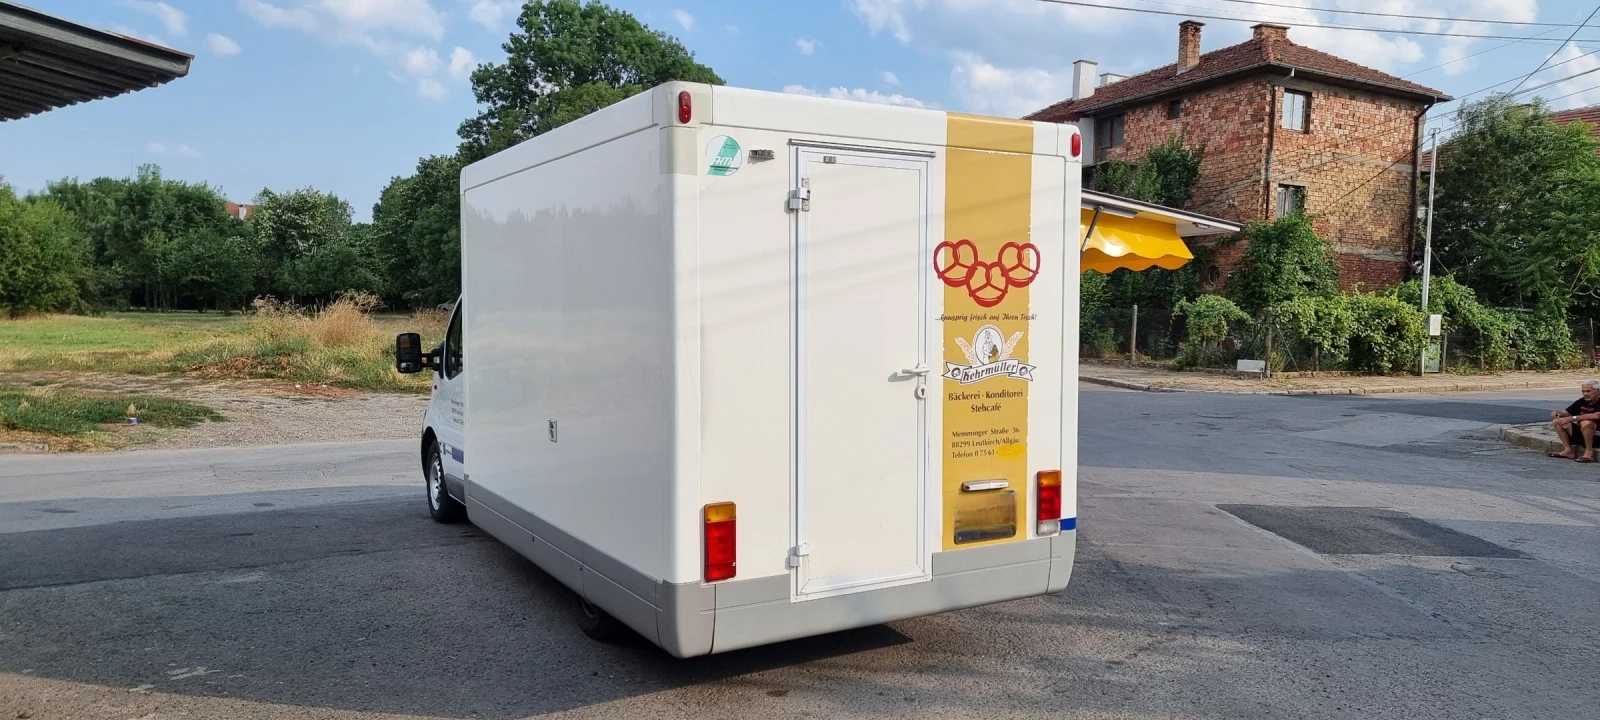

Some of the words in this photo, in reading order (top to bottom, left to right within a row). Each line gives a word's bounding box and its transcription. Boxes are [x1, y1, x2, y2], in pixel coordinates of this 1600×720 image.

[969, 313, 987, 322] frisch
[988, 313, 1000, 322] auf
[1001, 312, 1019, 321] Ihren
[962, 360, 1017, 382] Kehrmüller
[948, 391, 981, 402] Bäckerei
[985, 388, 1024, 400] Konditorei
[970, 402, 1002, 413] Stehcafé
[951, 429, 988, 438] Memminger
[990, 427, 1009, 435] Straße
[1012, 426, 1020, 434] 36
[951, 440, 971, 449] 88299
[951, 450, 974, 459] Telefon
